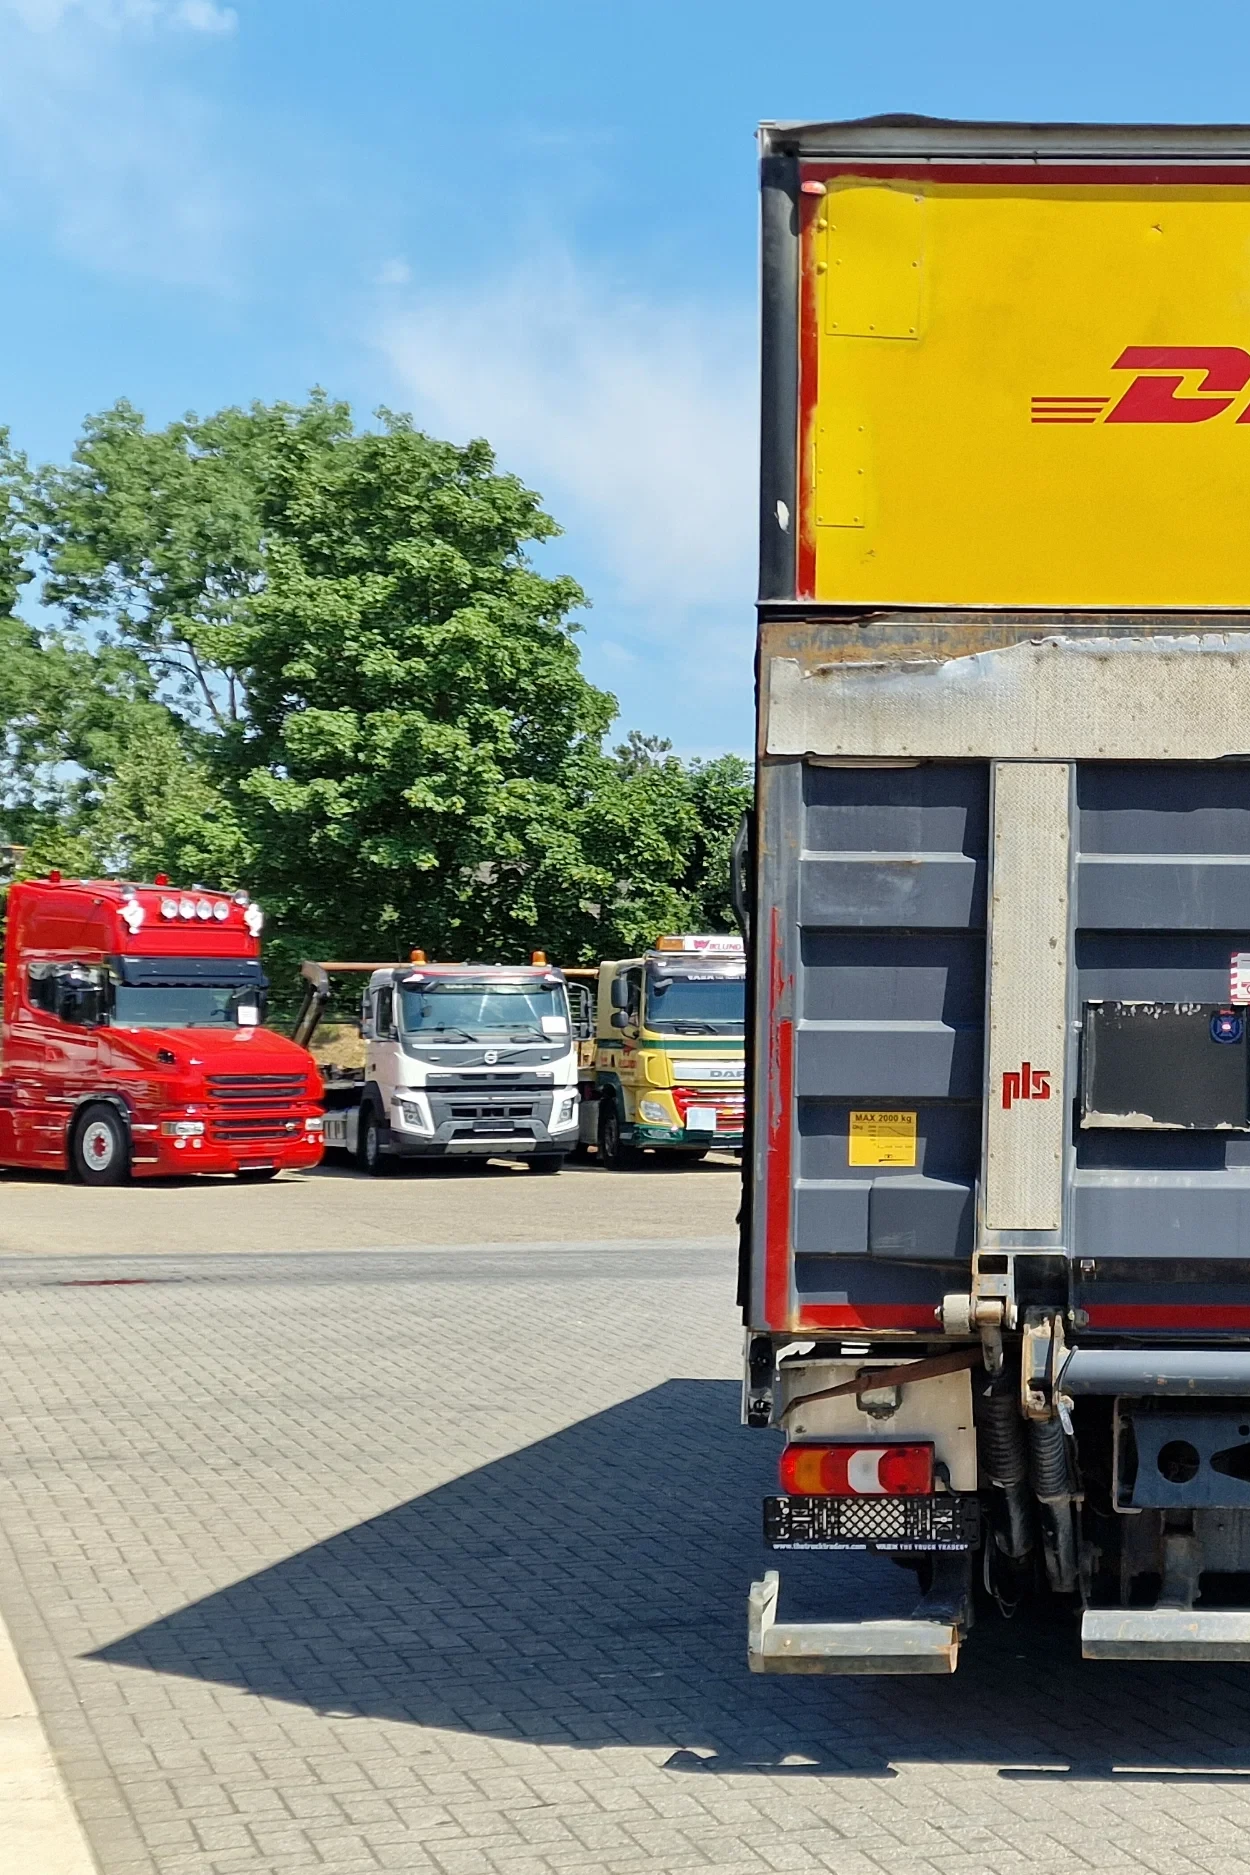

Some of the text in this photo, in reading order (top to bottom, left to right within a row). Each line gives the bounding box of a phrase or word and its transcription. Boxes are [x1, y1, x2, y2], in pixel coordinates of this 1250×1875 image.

[855, 1114, 912, 1124] MAX 2000 kg
